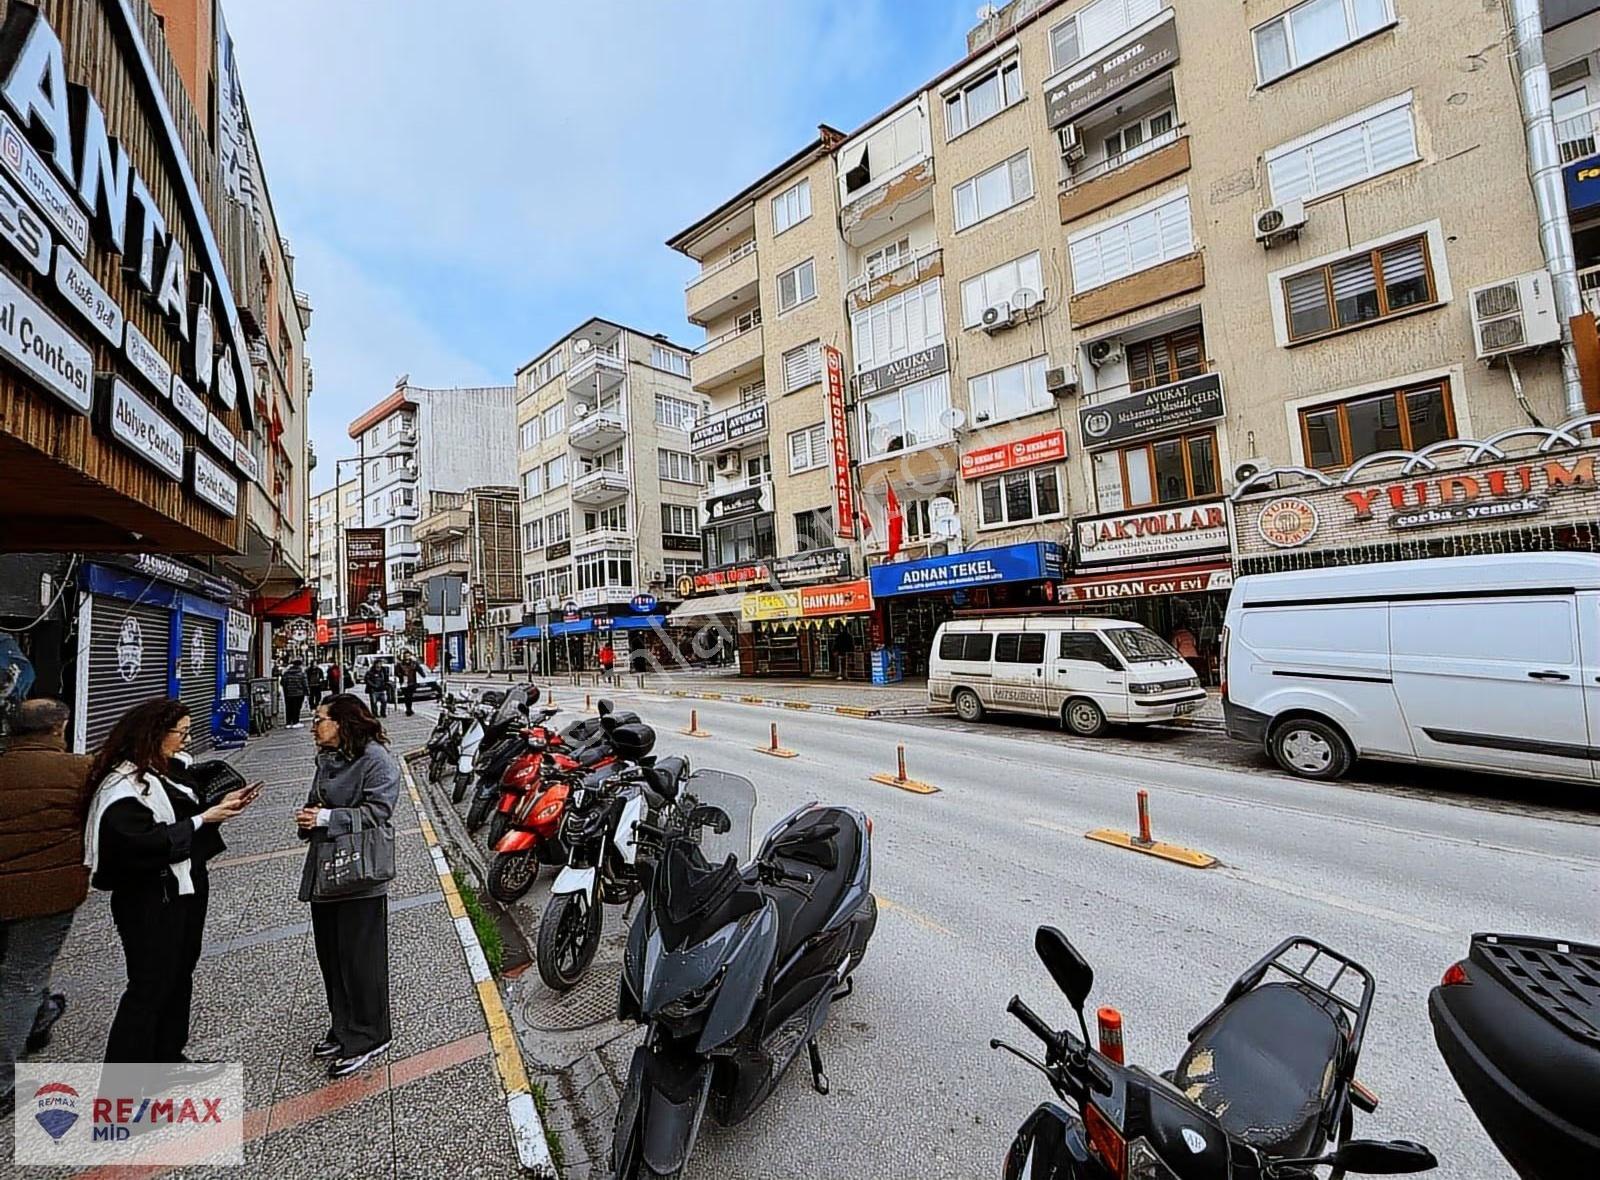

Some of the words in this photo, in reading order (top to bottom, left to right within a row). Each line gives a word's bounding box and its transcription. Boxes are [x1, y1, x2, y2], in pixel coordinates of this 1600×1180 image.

[19, 317, 88, 394] Çantası
[888, 348, 936, 375] AVUKAT
[1146, 386, 1188, 406] AVUKAT
[116, 398, 146, 438] Abiye
[729, 408, 764, 429] AVUKAT
[830, 374, 845, 461] DEMOKRAT
[692, 423, 723, 442] AVUKAT
[1343, 456, 1596, 519] YUDUM
[1264, 502, 1313, 518] YUDUM
[1397, 508, 1453, 526] çorba
[1467, 499, 1539, 519] yemek
[1099, 506, 1226, 543] AKYOLLAR
[903, 566, 949, 584] ADNAN
[950, 560, 997, 578] TEKEL
[1083, 581, 1146, 600] TURAN
[1148, 582, 1177, 595] ÇAY
[1181, 576, 1203, 591] EVİ
